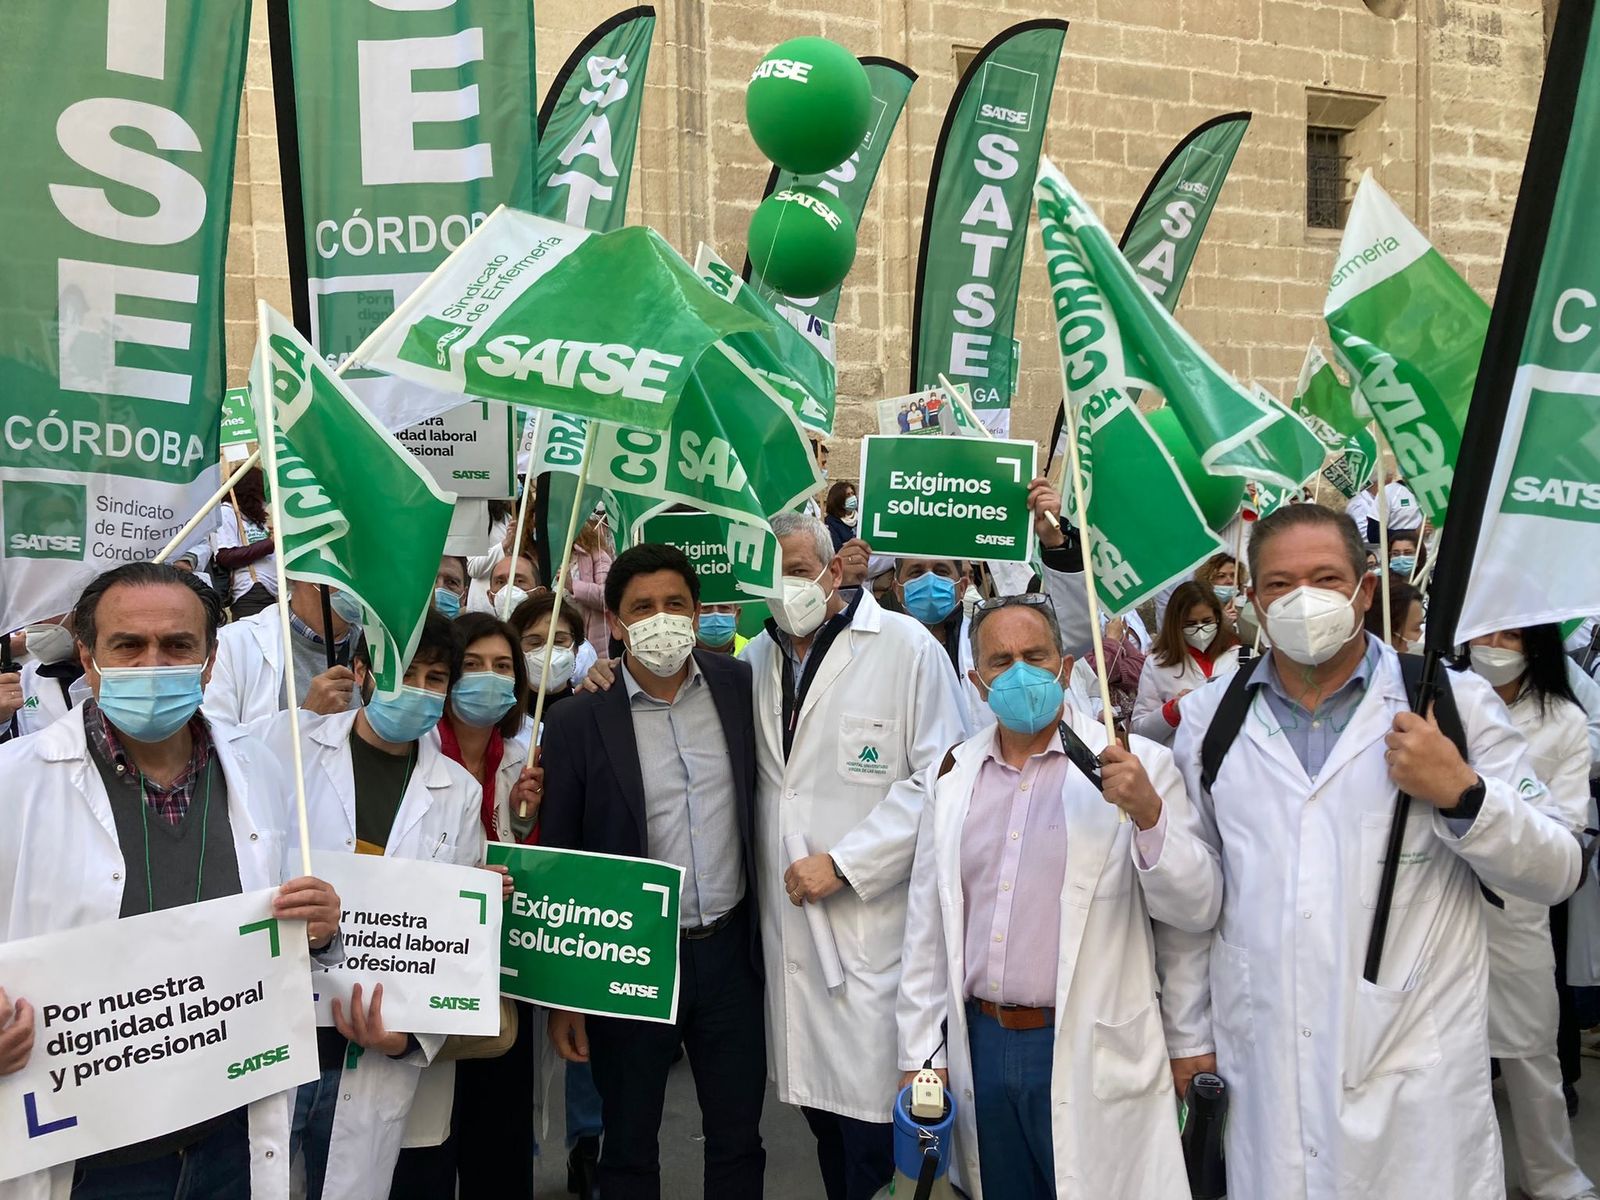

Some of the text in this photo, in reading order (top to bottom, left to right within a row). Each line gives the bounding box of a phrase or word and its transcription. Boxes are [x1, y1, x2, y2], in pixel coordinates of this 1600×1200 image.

[980, 104, 1028, 125] SATSE
[775, 190, 842, 231] SATSE
[950, 133, 1020, 378] SATSE
[1329, 236, 1400, 292] ermería
[442, 254, 509, 319] Sindicato
[466, 303, 489, 323] de
[476, 334, 685, 404] SATSE
[4, 410, 204, 468] CÓRDOBA
[429, 430, 477, 442] laboral
[402, 443, 454, 456] esional
[452, 470, 490, 480] SATSE
[889, 471, 992, 496] Exigimos
[95, 495, 174, 520] Sindicato
[887, 496, 1008, 521] soluciones
[95, 519, 191, 541] de Enferm
[975, 534, 1016, 546] SATSE
[10, 533, 81, 553] SATSE
[353, 910, 428, 929] nuestra
[511, 892, 634, 931] Exigimos
[341, 930, 470, 955] nidad laboral
[507, 927, 651, 966] soluciones
[43, 974, 205, 1028] Por nuestra
[608, 982, 659, 999] SATSE
[429, 996, 481, 1011] SATSE
[46, 981, 264, 1057] dignidad laboral
[49, 1020, 227, 1093] y profesional
[226, 1044, 290, 1080] SATSE
